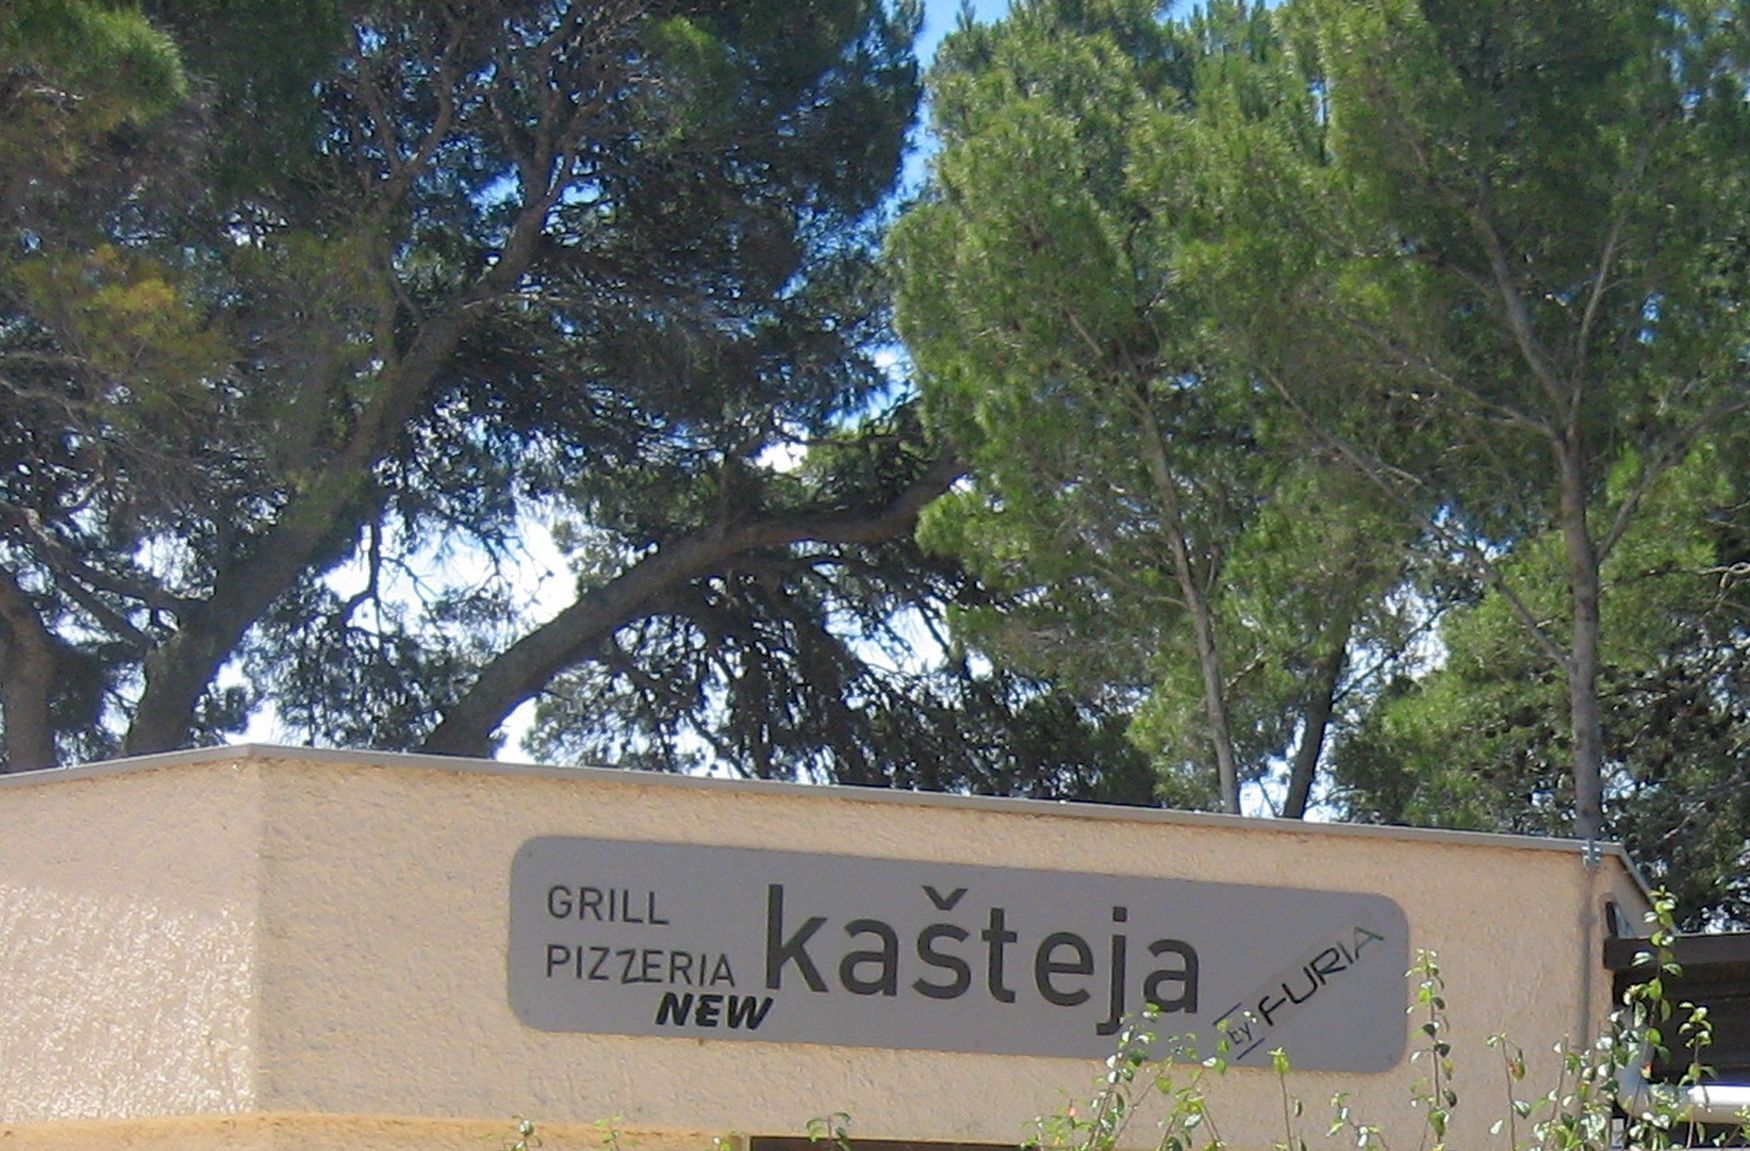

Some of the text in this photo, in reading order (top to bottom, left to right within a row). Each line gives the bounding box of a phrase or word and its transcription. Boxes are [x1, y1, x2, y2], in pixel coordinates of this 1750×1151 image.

[548, 885, 670, 925] GRILL
[546, 944, 736, 987] PIZZERIA
[765, 883, 1200, 1036] kašteja
[1258, 926, 1385, 1026] FURIA
[655, 991, 774, 1030] NEW
